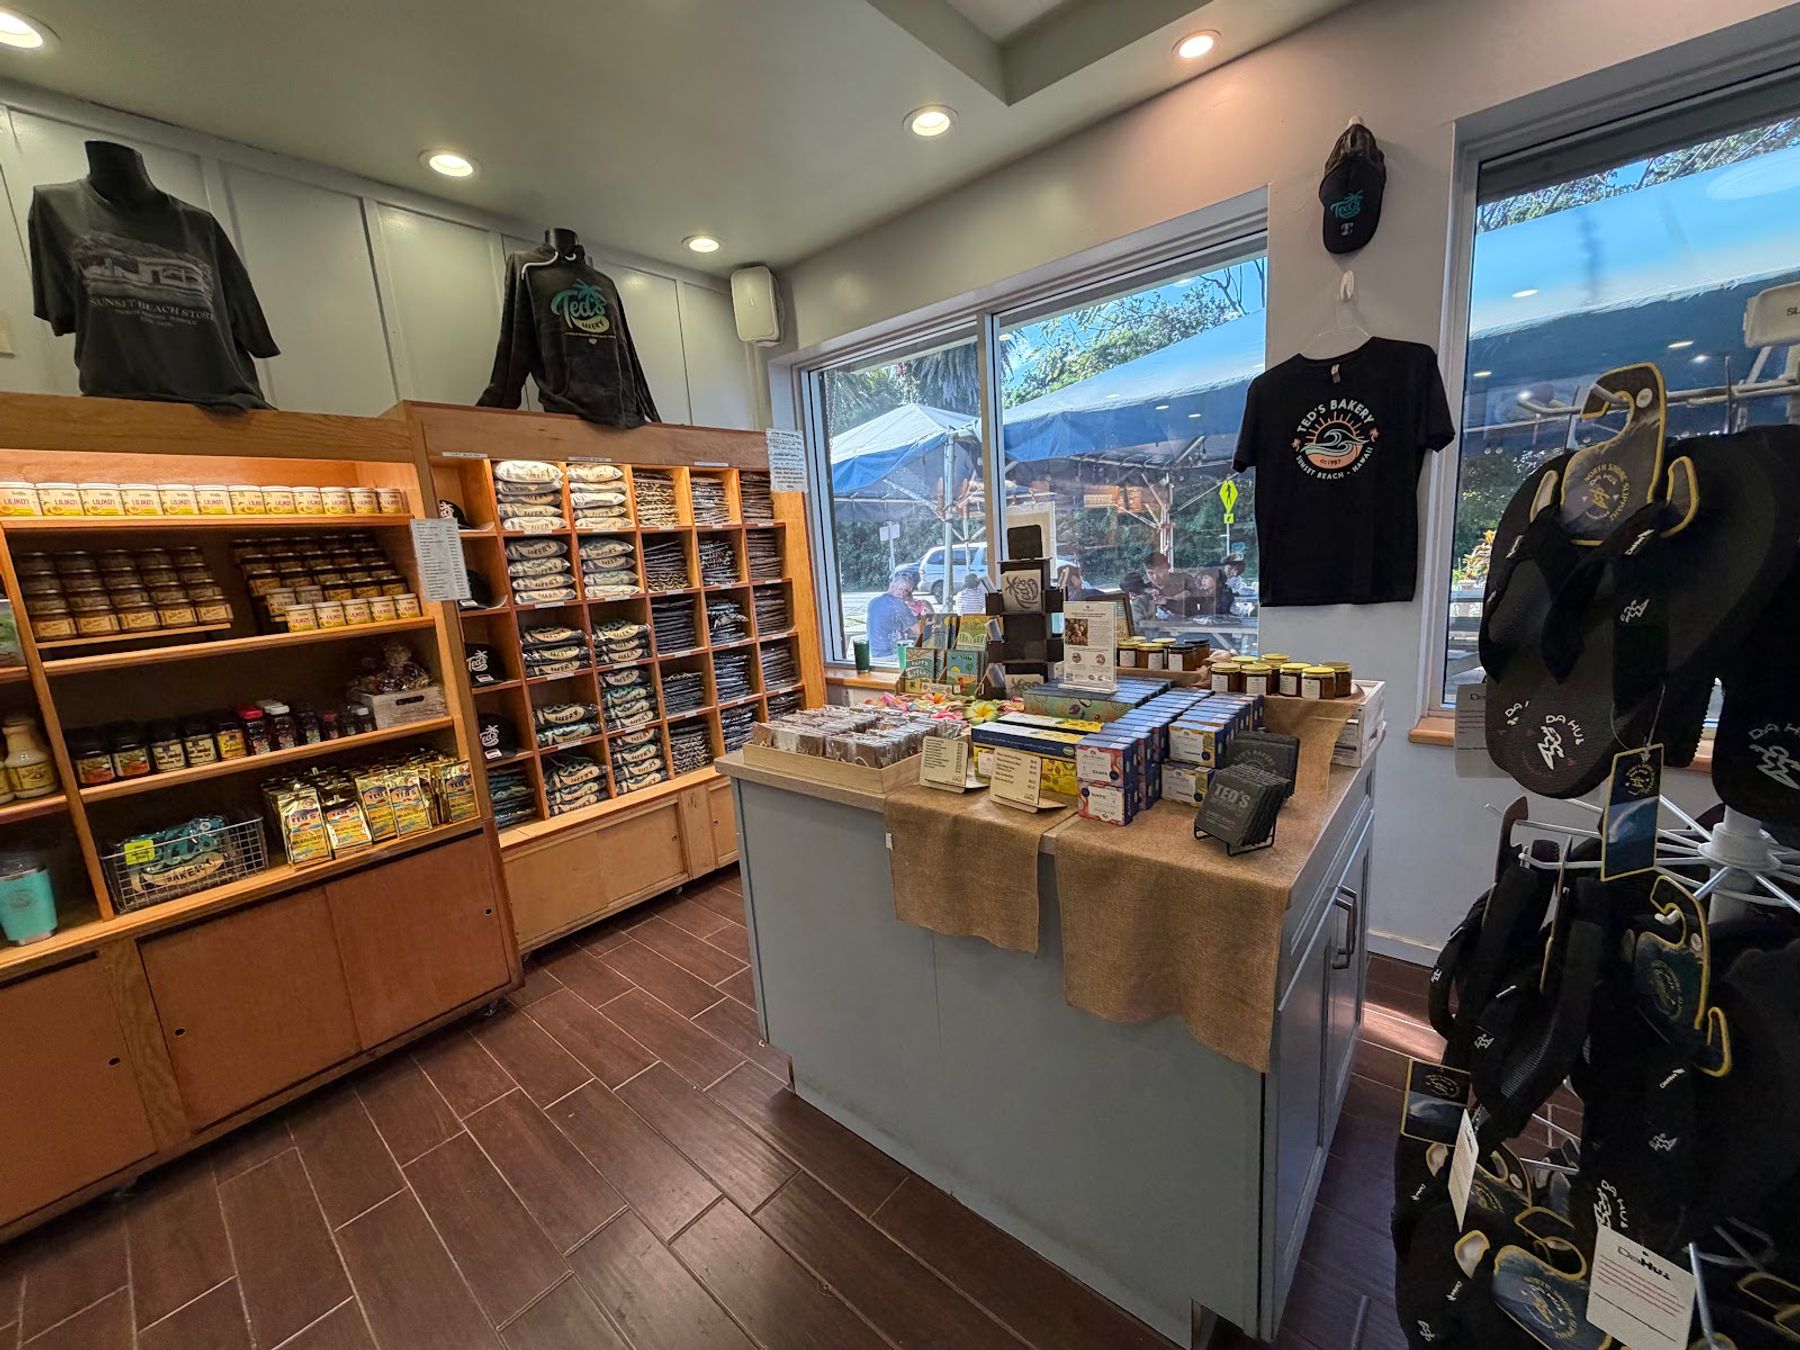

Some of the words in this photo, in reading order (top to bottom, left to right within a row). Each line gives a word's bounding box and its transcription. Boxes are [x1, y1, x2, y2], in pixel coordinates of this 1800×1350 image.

[1296, 404, 1327, 432] TED'S
[1330, 398, 1375, 424] BAKERY
[1296, 455, 1316, 476] SUNSET
[1316, 471, 1345, 480] BEACH
[1351, 446, 1374, 472] HAWAII
[1214, 783, 1251, 809] TED'S
